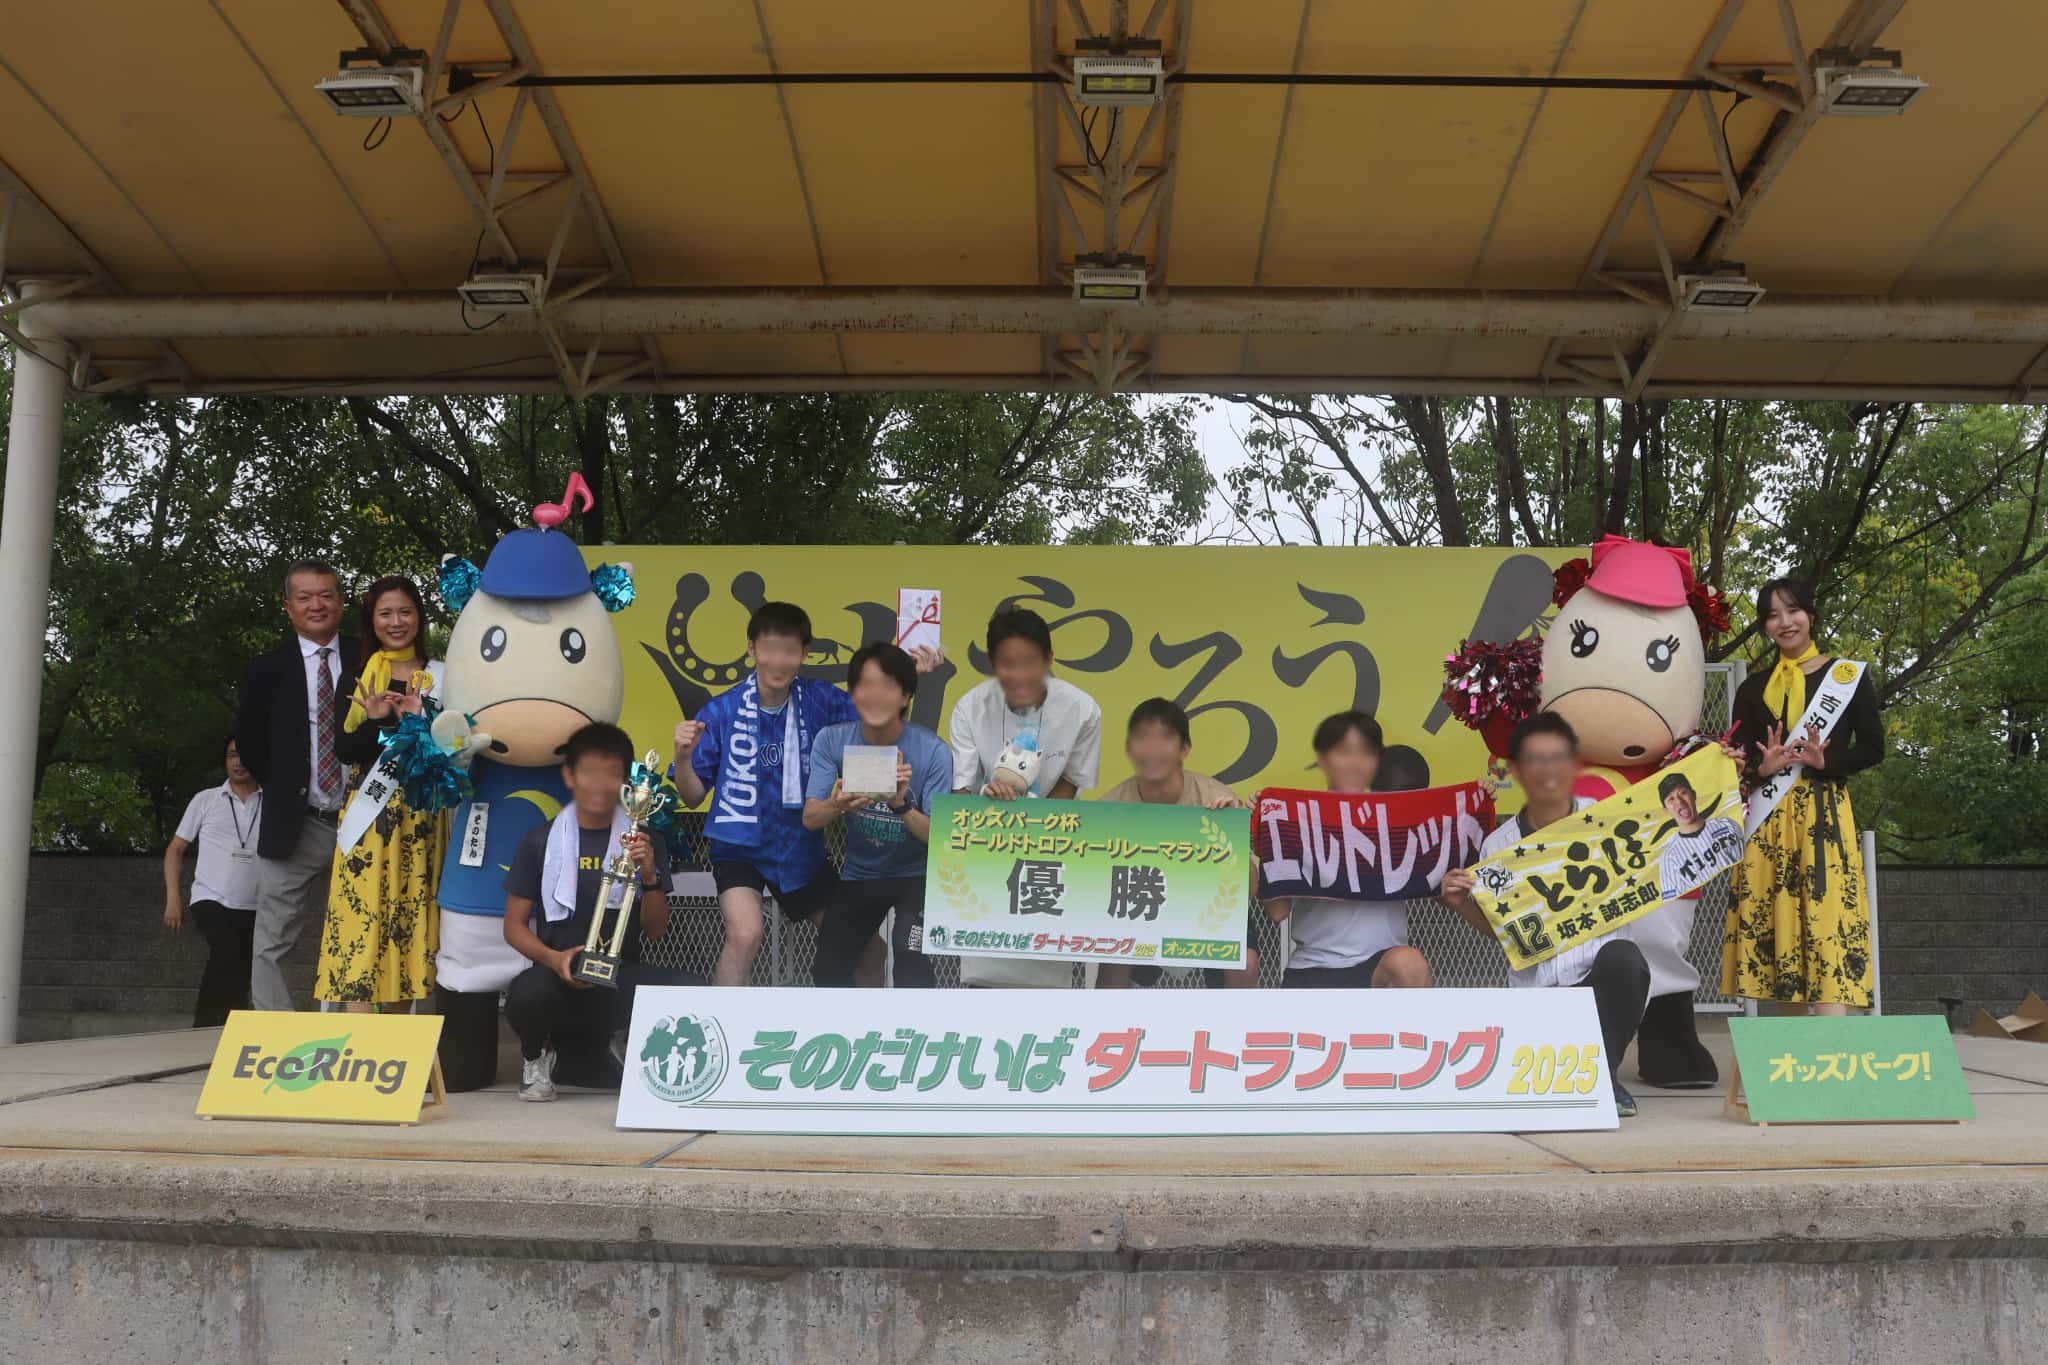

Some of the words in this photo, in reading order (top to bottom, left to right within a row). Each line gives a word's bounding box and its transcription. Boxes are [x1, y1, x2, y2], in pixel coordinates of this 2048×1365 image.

[469, 814, 482, 859] そのたん
[952, 808, 1081, 833] オッズパーク杯
[950, 832, 1231, 864] ゴールドトロフィーリレーマラソン
[1680, 834, 1737, 881] Tigers
[1006, 858, 1168, 921] 優勝
[1556, 911, 1598, 940] 坂本
[1599, 881, 1660, 923] 誠志郎
[951, 929, 1034, 950] そのだけいば
[1033, 933, 1135, 954] ダートランニング
[1503, 912, 1554, 959] 12
[738, 1027, 1081, 1093] そのだけいば
[1084, 1025, 1504, 1093] ダートランニング
[1506, 1044, 1600, 1095] 2025
[1768, 1051, 1933, 1083] オッズパーク!
